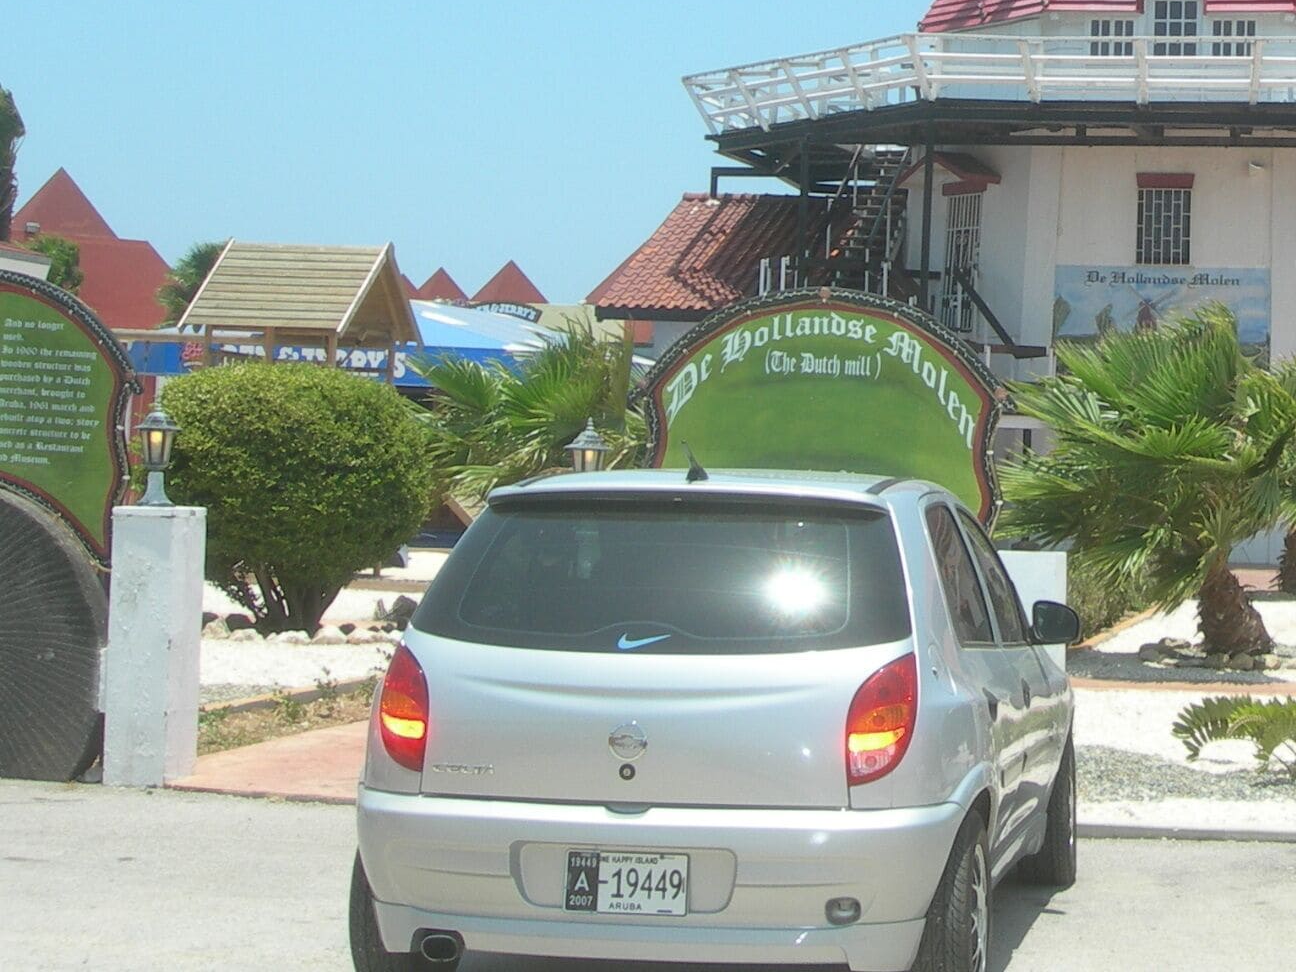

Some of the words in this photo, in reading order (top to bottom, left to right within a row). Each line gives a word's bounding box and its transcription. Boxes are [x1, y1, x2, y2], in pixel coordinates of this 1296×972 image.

[1085, 270, 1107, 287] De
[1109, 271, 1186, 287] Hollandse
[1187, 273, 1240, 289] Molen
[800, 352, 841, 377] Dutch
[665, 353, 712, 429] De
[720, 311, 878, 373] Hollandse
[882, 330, 976, 450] Molen
[570, 857, 597, 868] 19449
[574, 870, 590, 891] A
[568, 894, 594, 907] 2007
[608, 902, 642, 911] ARUBA
